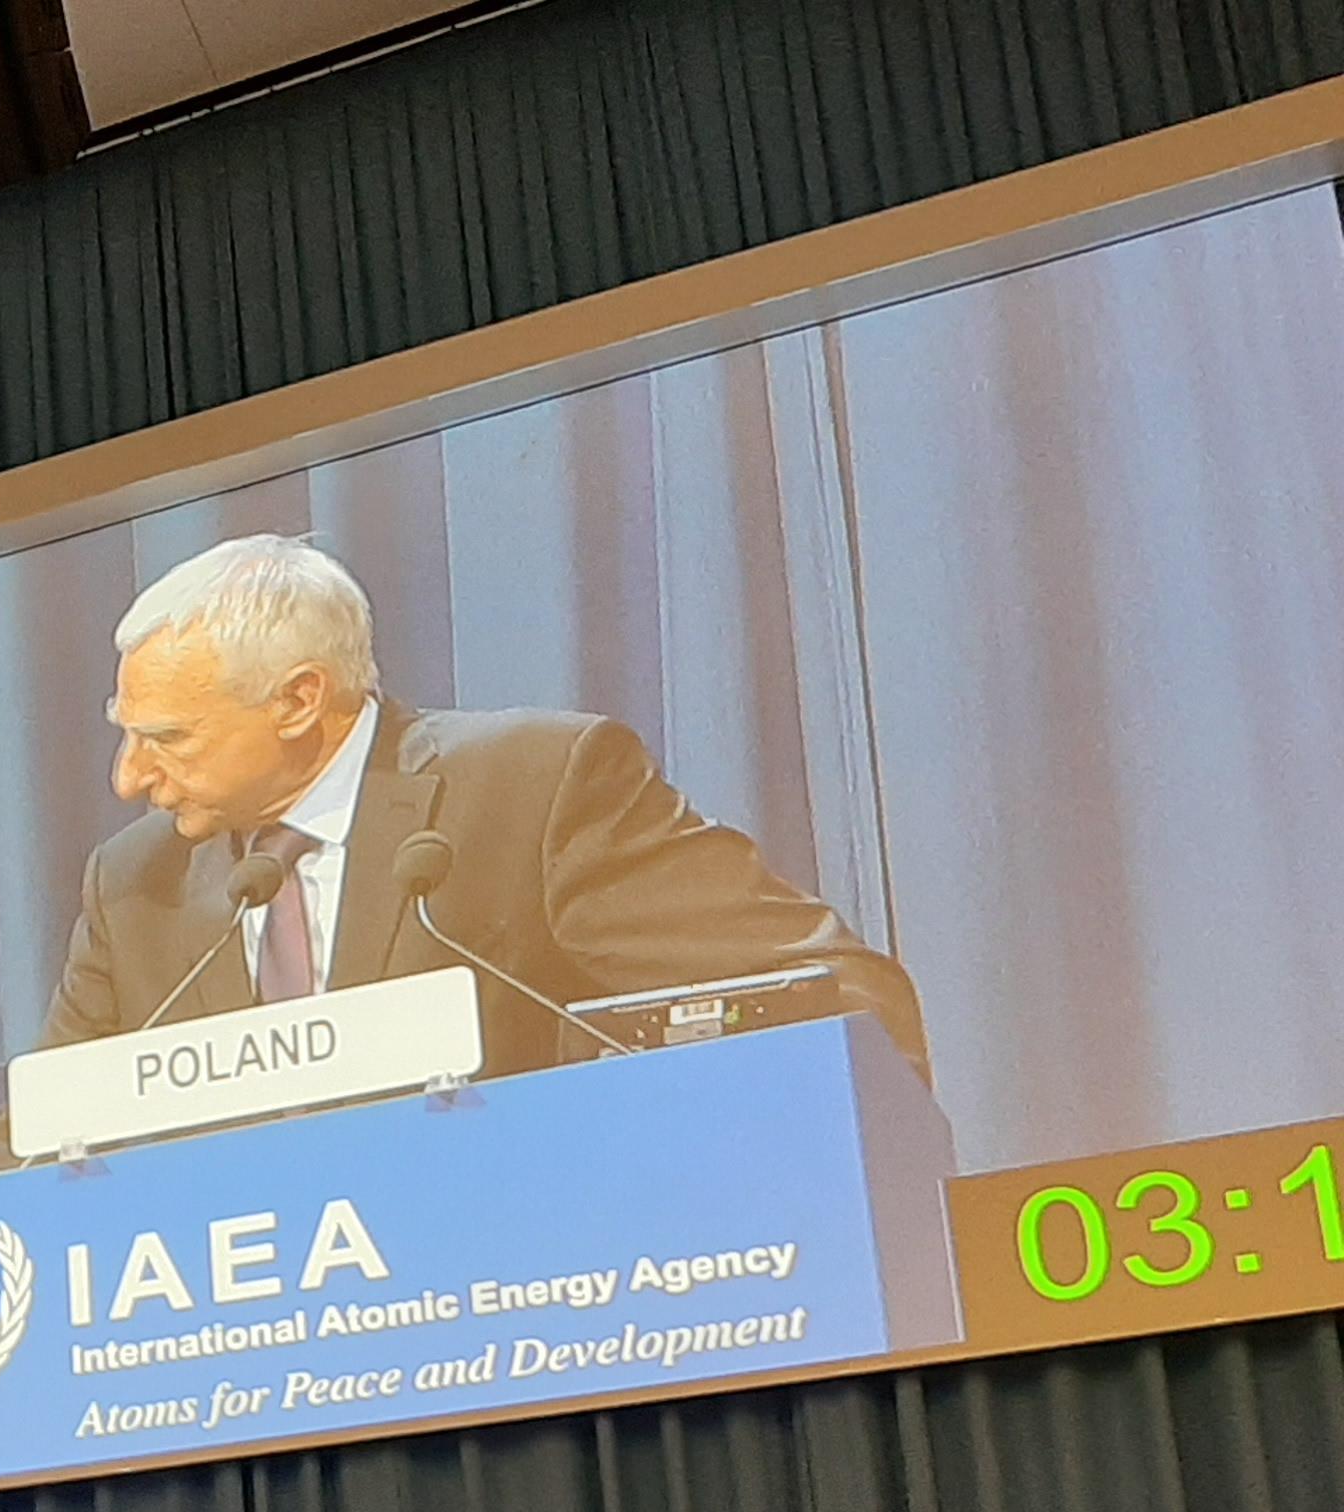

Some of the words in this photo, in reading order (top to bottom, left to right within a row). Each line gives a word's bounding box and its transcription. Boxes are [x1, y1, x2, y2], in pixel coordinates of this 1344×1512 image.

[134, 1018, 338, 1097] POLAND
[66, 1198, 391, 1327] IAEA
[1016, 1144, 1344, 1302] 03:1
[71, 1310, 308, 1375] International
[316, 1289, 461, 1338] Atomic
[469, 1268, 619, 1308] Energy
[627, 1241, 798, 1294] Agency
[74, 1400, 200, 1438] Atoms
[201, 1380, 272, 1429] for
[280, 1370, 403, 1409] Peace
[414, 1343, 499, 1390] and
[507, 1305, 808, 1368] Development
